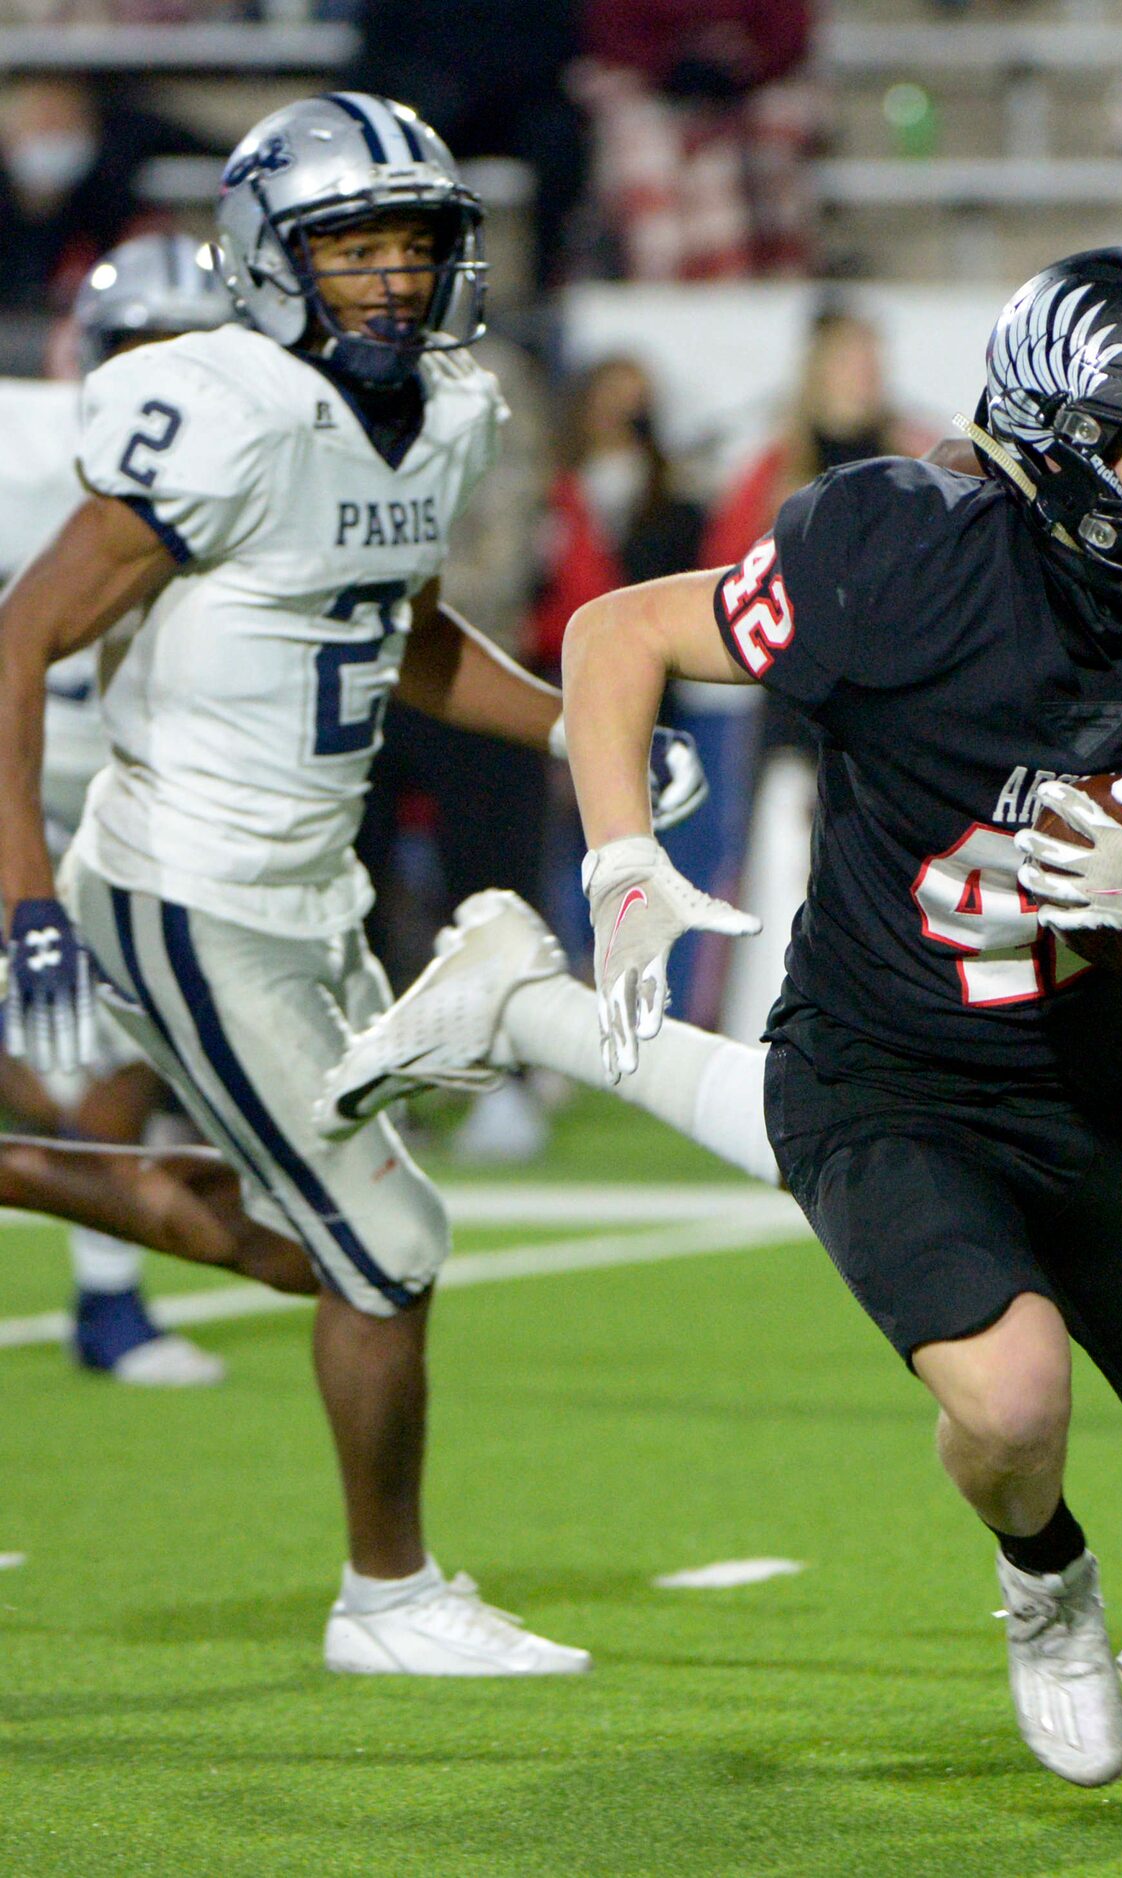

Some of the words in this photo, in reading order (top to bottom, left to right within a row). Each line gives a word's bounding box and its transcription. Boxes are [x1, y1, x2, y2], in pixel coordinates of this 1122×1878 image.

[120, 400, 182, 488] 2
[335, 496, 438, 546] PARIS
[312, 578, 408, 757] 2
[721, 538, 796, 680] 42
[909, 821, 1098, 1008] 4
